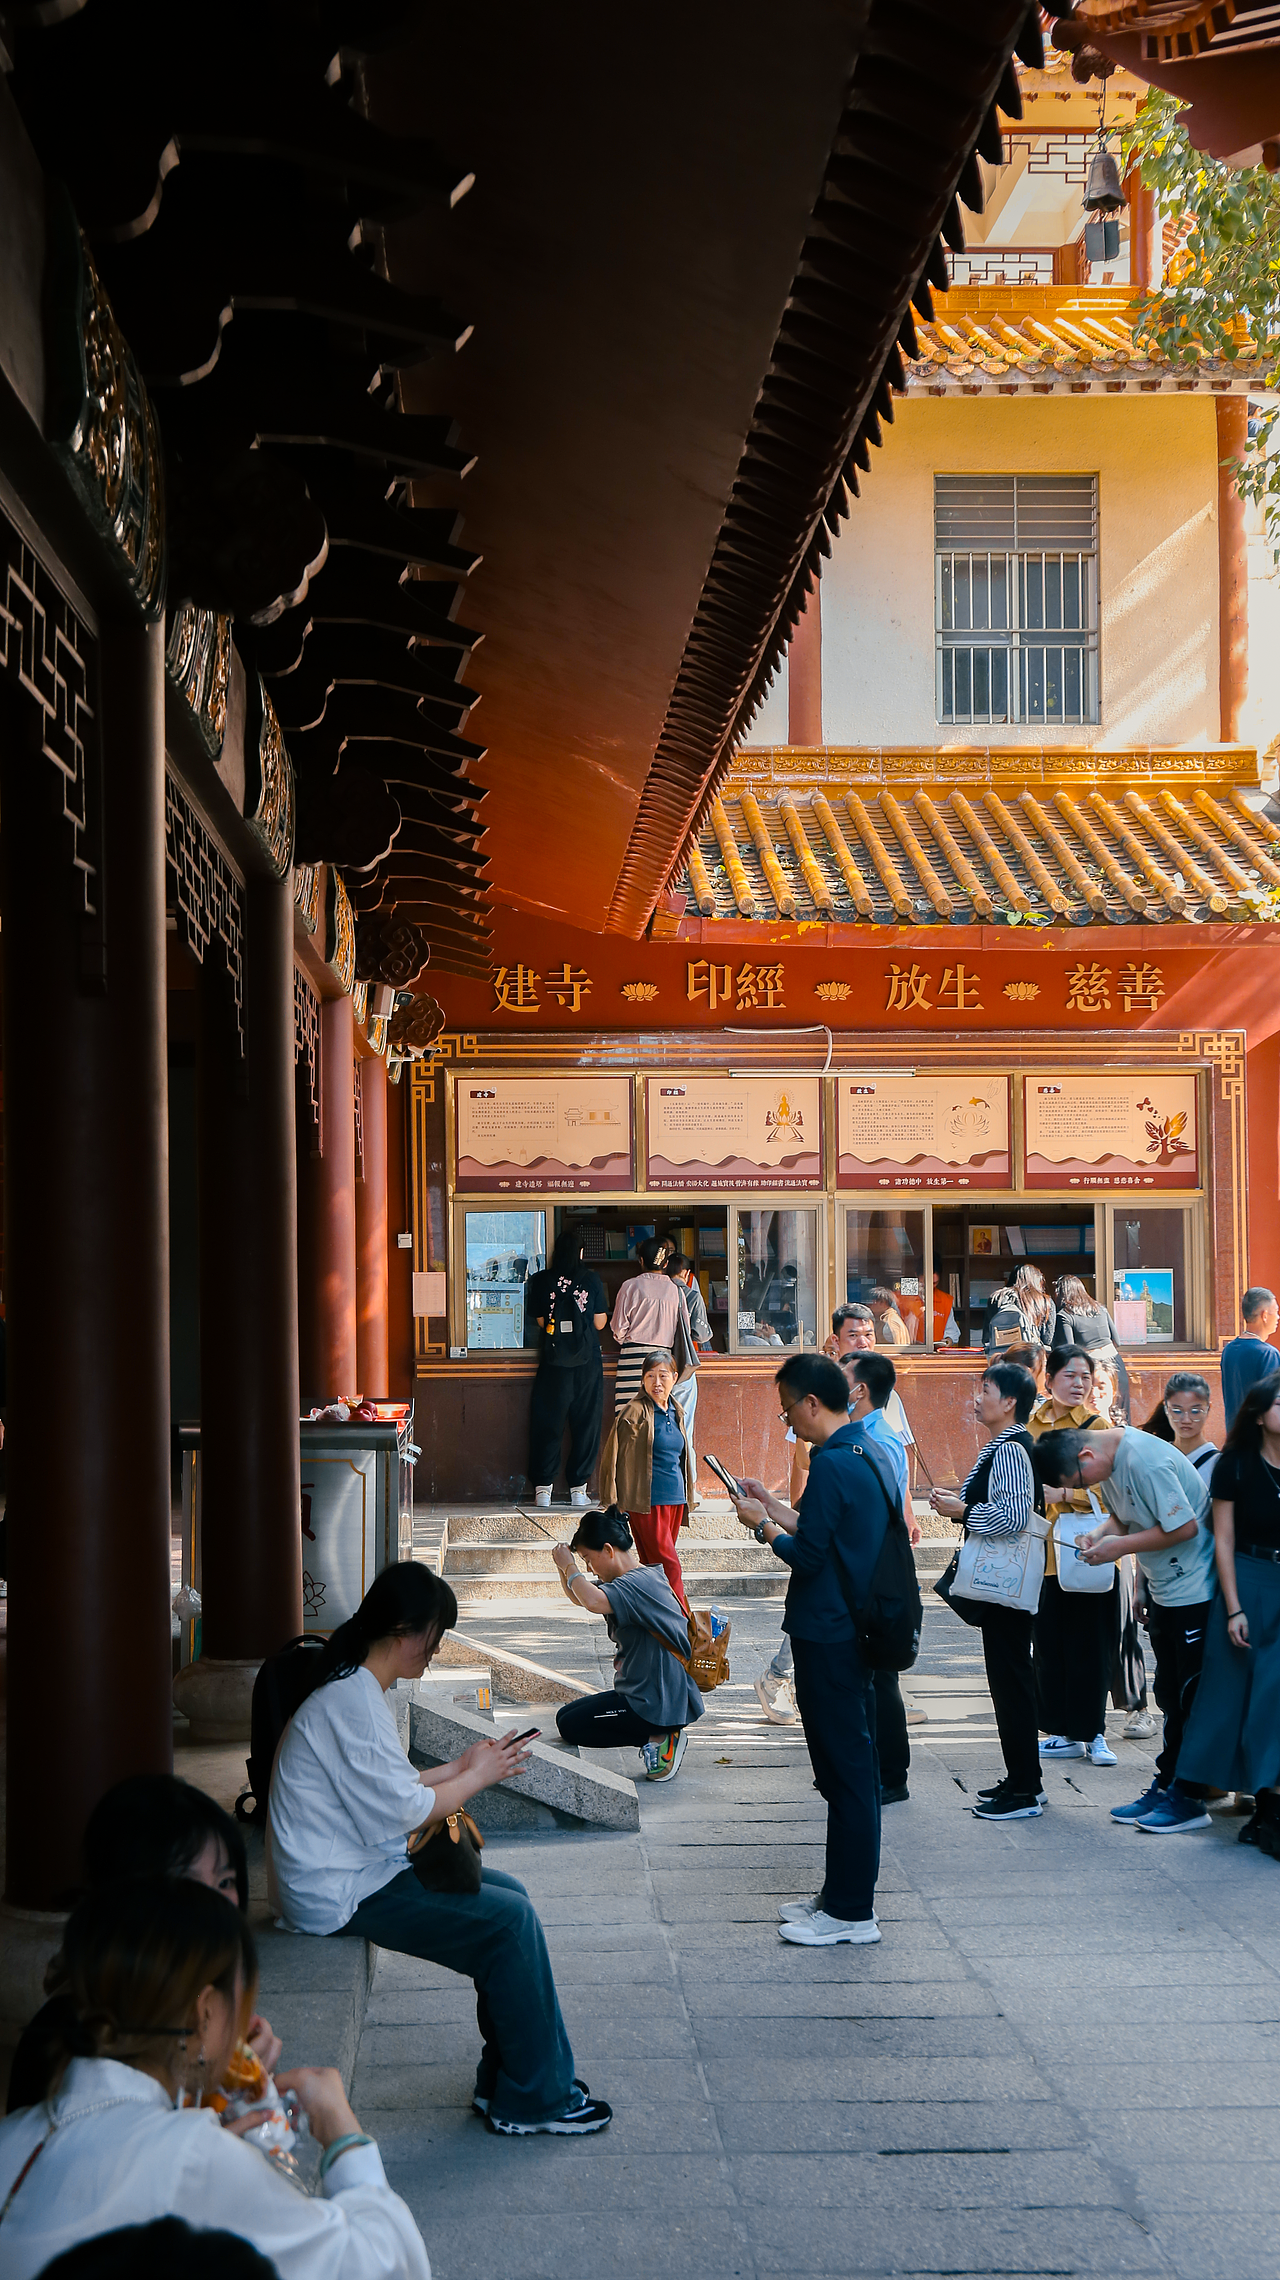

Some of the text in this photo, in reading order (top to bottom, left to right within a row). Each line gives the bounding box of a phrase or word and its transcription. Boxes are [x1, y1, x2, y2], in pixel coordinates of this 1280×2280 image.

[491, 959, 1166, 1013] 建寺 印經 放生 慈善
